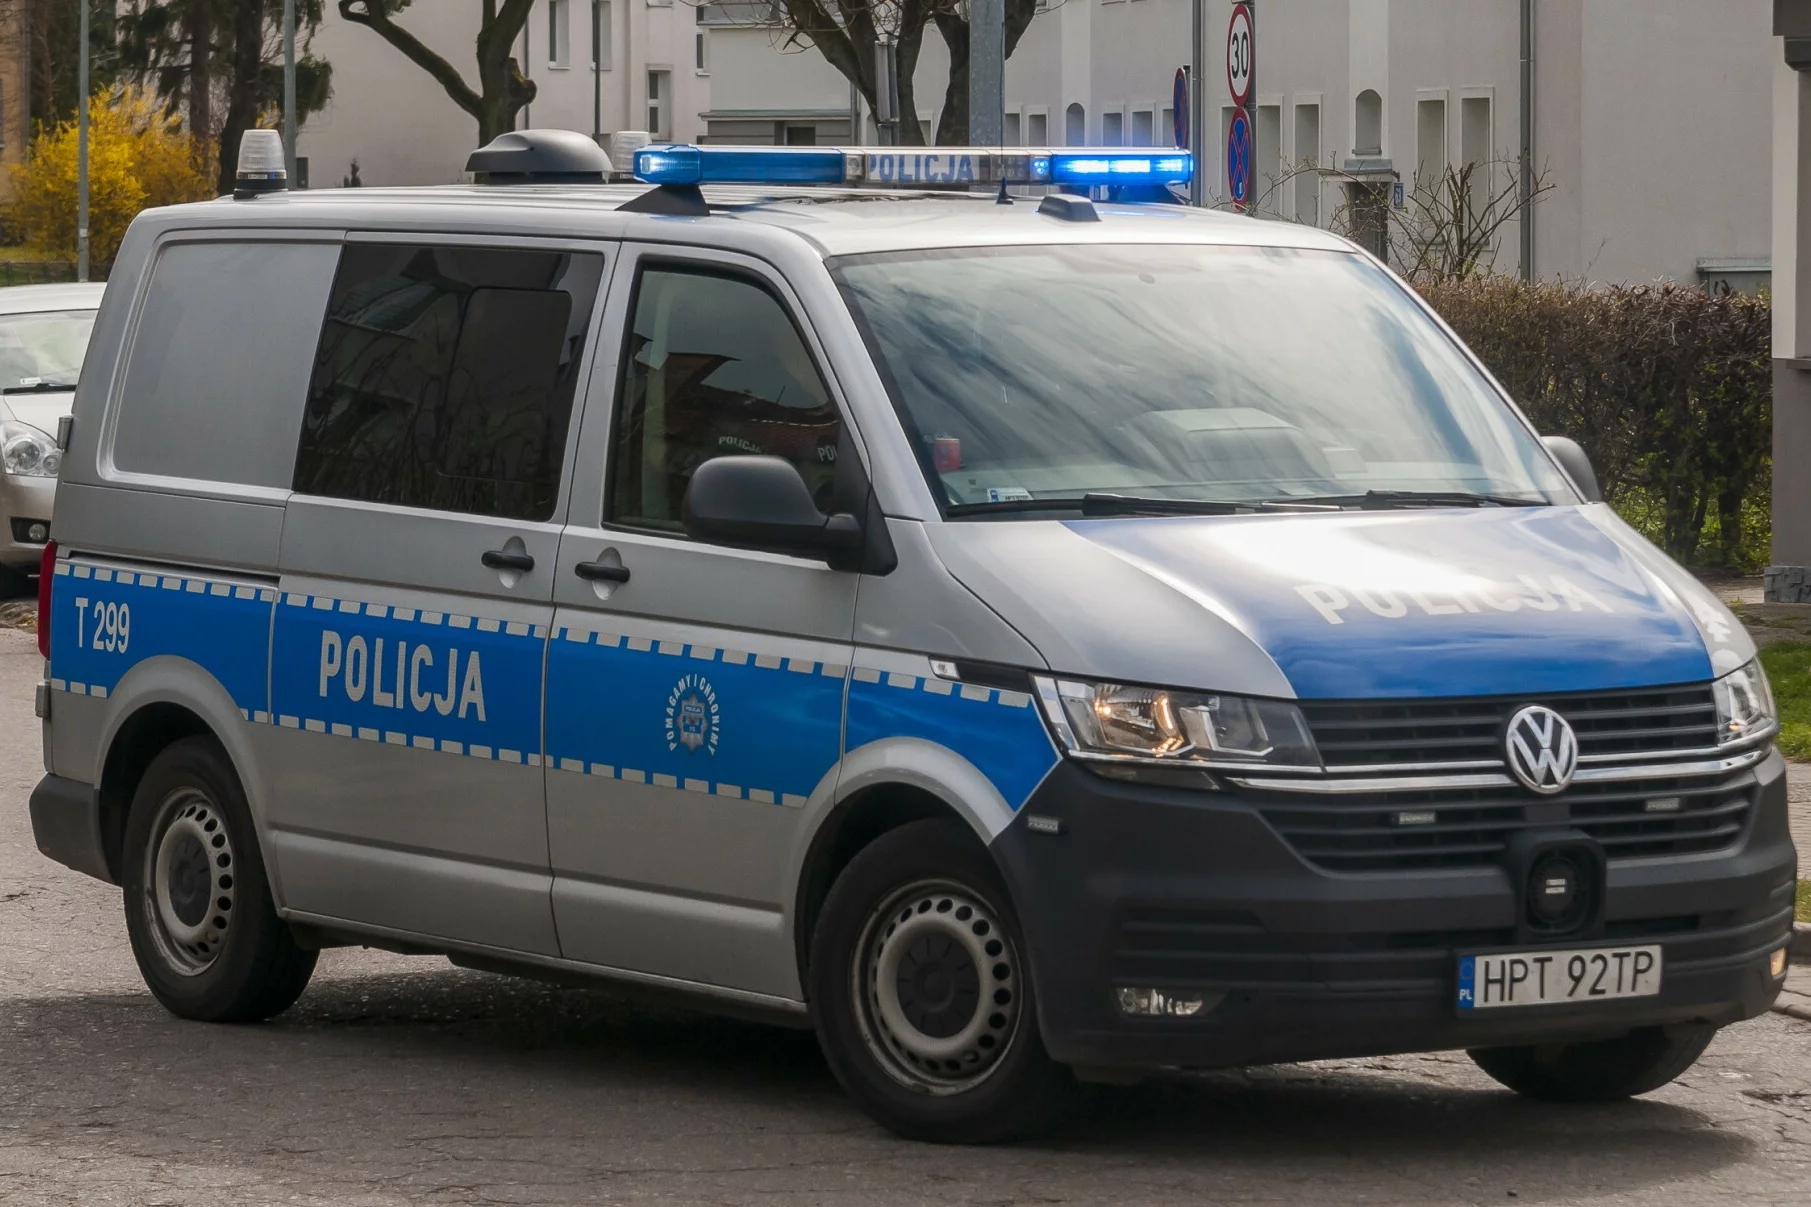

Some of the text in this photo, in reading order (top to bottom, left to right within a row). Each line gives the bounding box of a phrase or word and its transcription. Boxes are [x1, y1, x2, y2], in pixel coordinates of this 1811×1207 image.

[1231, 31, 1249, 79] 30
[76, 597, 130, 654] T 299
[319, 630, 487, 722] POLICJA
[665, 674, 691, 751] POMAGAMY
[699, 677, 720, 756] CHRONIMY
[1459, 989, 1472, 1000] PL
[1483, 951, 1654, 1002] HPT 92TP
